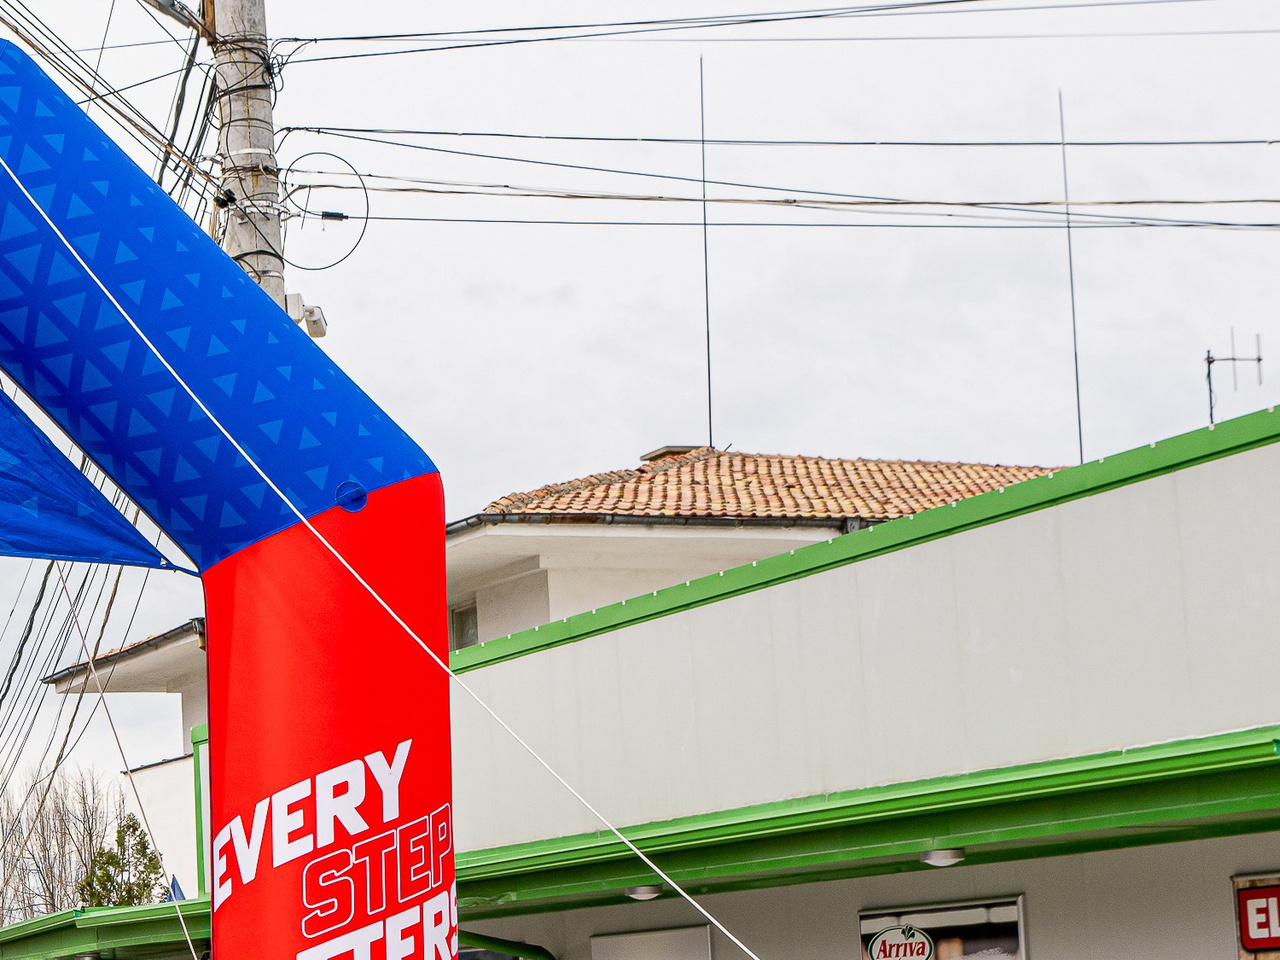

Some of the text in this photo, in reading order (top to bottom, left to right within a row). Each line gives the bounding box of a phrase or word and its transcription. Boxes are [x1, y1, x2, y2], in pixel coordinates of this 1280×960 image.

[213, 739, 412, 913] EVERY
[301, 802, 452, 938] STEP
[876, 939, 926, 960] Arriva
